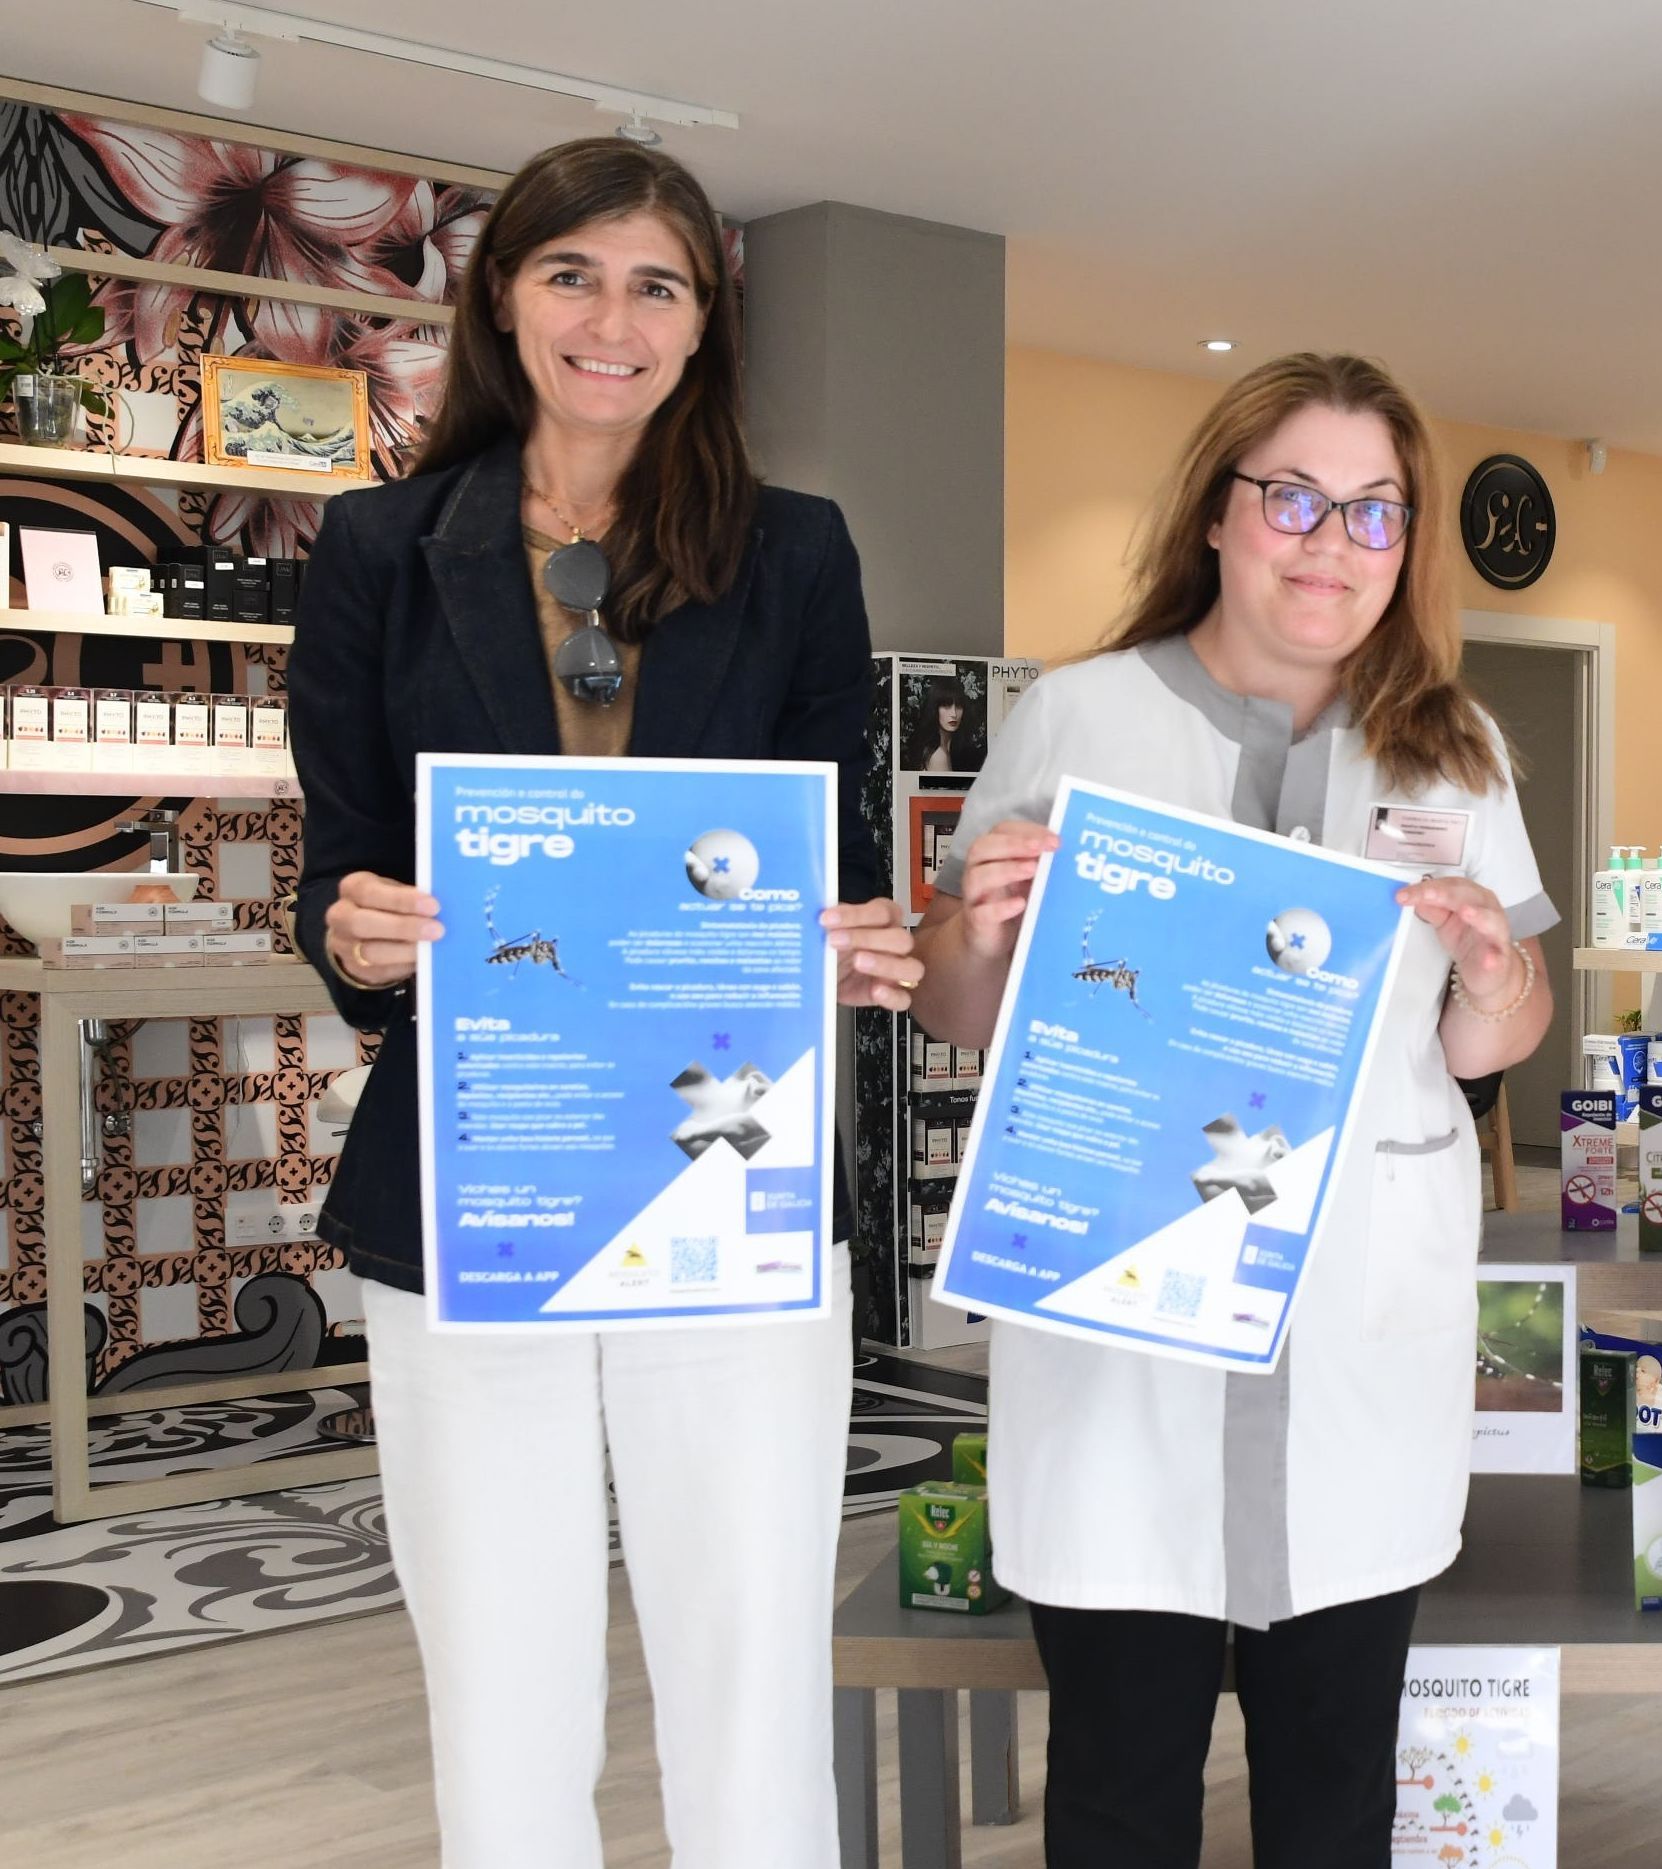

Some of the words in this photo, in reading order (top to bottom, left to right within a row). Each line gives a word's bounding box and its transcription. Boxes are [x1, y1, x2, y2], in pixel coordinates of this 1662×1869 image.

[992, 665, 1039, 680] PHYTO
[455, 803, 636, 831] mosquito
[454, 826, 575, 866] tigre
[1080, 829, 1235, 887] mosquito
[1074, 850, 1177, 900] tigre
[739, 888, 800, 901] Como
[1306, 966, 1360, 990] Como
[455, 1017, 511, 1032] Evita
[1029, 1019, 1079, 1044] Evita
[1572, 1100, 1612, 1112] GOIBI
[1572, 1135, 1613, 1147] XTREME
[457, 1197, 532, 1208] mosquito
[536, 1195, 584, 1209] tigre?
[988, 1182, 1054, 1208] mosquito
[1057, 1197, 1100, 1218] tigre?
[971, 1250, 1028, 1275] DESCARGA
[1028, 1266, 1038, 1278] A
[1038, 1268, 1061, 1282] APP
[458, 1271, 522, 1283] DESCARGA
[523, 1272, 534, 1282] A
[535, 1270, 560, 1282] APP
[1473, 1426, 1510, 1439] pictus
[930, 1504, 950, 1519] Relec
[1487, 1678, 1531, 1698] TIGRE
